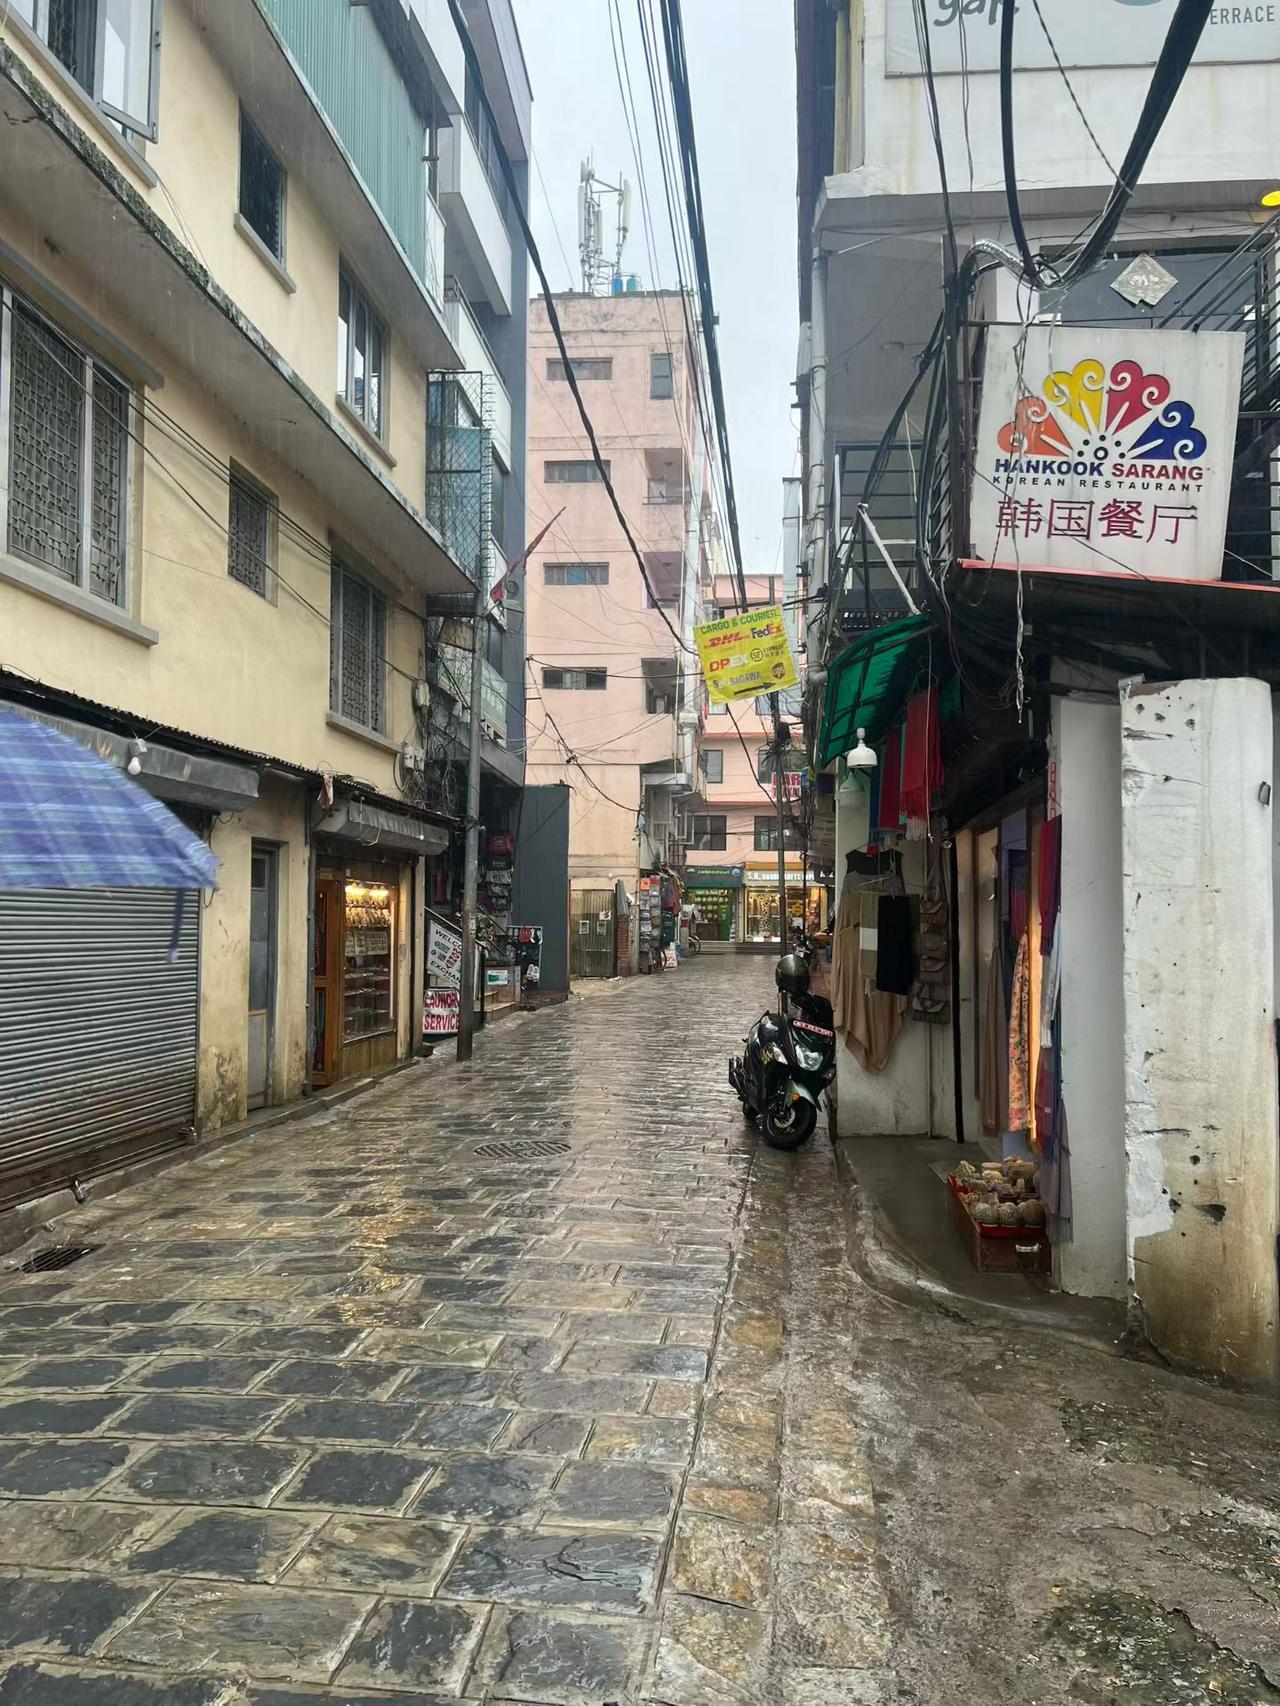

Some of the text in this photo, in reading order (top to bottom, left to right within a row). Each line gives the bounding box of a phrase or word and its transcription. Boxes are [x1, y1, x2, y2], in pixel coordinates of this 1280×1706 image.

[1210, 5, 1276, 25] ERRACE
[994, 458, 1204, 480] HANKOOK SARANG
[993, 476, 1204, 492] KOREAN RESTAURANT
[995, 498, 1199, 544] 韩国餐厅
[700, 621, 729, 634] CARGO
[740, 609, 776, 624] COURIER
[750, 623, 781, 639] FedEx
[708, 633, 744, 646] DHL
